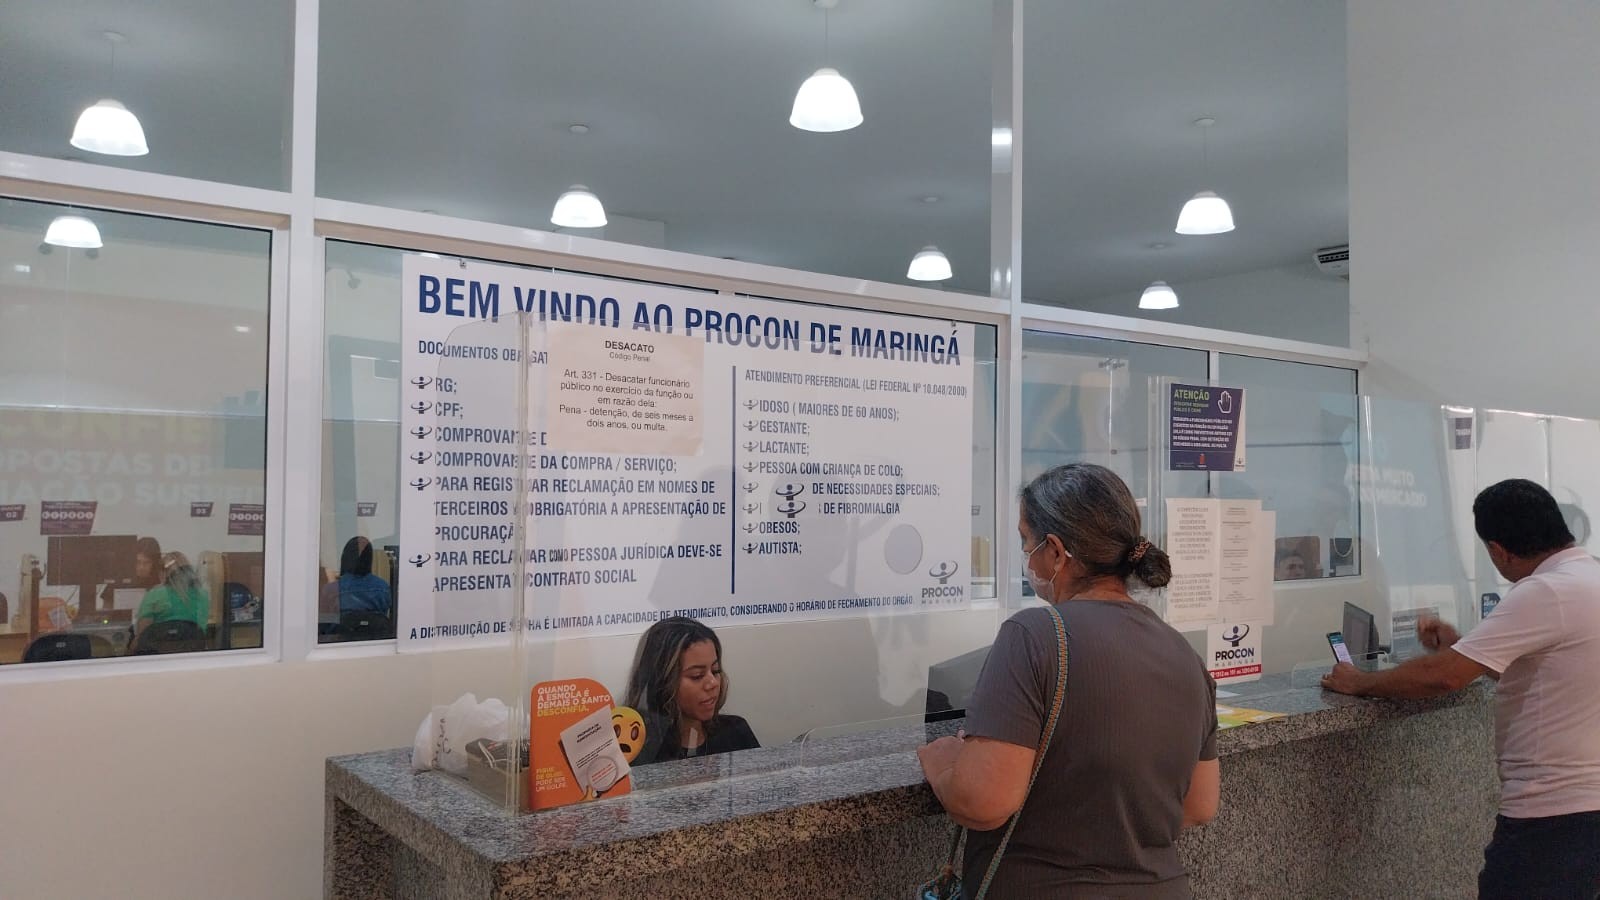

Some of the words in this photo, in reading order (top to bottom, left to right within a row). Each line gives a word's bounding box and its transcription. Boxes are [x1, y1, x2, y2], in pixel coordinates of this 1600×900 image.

[419, 275, 500, 323] BEM
[514, 286, 620, 329] VINDO
[633, 302, 673, 334] AO
[685, 307, 800, 352] PROCON
[810, 322, 842, 355] DE
[851, 327, 961, 366] MARINGÁ
[418, 340, 498, 361] DOCUMENTOS
[605, 340, 655, 354] DESACATO
[609, 352, 632, 361] Código
[633, 353, 651, 362] Penal
[435, 377, 457, 395] RG;
[564, 369, 579, 379] Art.
[581, 371, 597, 380] 331
[605, 372, 647, 384] Desacatar
[649, 376, 691, 388] funcionário
[745, 369, 803, 385] ATENDIMENTO
[805, 375, 861, 390] PREFERENCIAL
[862, 378, 877, 392] (LEI
[879, 380, 911, 393] FEDERAL
[923, 383, 968, 398] 10.048/2000)
[560, 382, 591, 392] público
[605, 385, 642, 395] exercício
[644, 387, 654, 396] da
[656, 388, 682, 400] função
[1174, 389, 1210, 402] ATENÇÃO
[613, 397, 635, 406] razão
[435, 401, 464, 420] CPF;
[559, 405, 581, 415] Pena
[589, 407, 629, 419] detenção,
[632, 408, 643, 418] de
[645, 410, 660, 419] seis
[662, 412, 687, 421] meses
[759, 400, 790, 414] IDOSO
[798, 402, 839, 417] MAIORES
[841, 404, 854, 417] DE
[855, 405, 867, 418] 60
[869, 406, 900, 421] ANOS);
[587, 419, 604, 428] dois
[759, 420, 810, 436] GESTANTE;
[759, 441, 810, 456] LACTANTE;
[541, 455, 558, 470] DA
[561, 456, 613, 471] COMPRA
[624, 457, 677, 475] SERVIÇO;
[759, 461, 798, 475] PESSOA
[800, 463, 821, 476] COM
[822, 463, 862, 478] CRIANÇA
[864, 465, 876, 476] DE
[878, 465, 904, 478] COLO;
[435, 476, 469, 492] PARA
[553, 477, 634, 496] RECLAMAÇÃO
[638, 480, 655, 493] EM
[658, 480, 698, 494] NOMES
[701, 481, 715, 494] DE
[812, 482, 825, 495] DE
[826, 483, 893, 496] NECESSIDADES
[895, 483, 941, 497] ESPECIAIS;
[434, 501, 508, 516] TERCEIROS
[611, 502, 618, 516] A
[622, 500, 709, 518] APRESENTAÇÃO
[713, 502, 726, 515] DE
[823, 502, 836, 514] DE
[838, 502, 901, 515] FIBROMIALGIA
[759, 521, 800, 535] OBESOS;
[434, 551, 468, 567] PARA
[549, 548, 569, 562] COMO
[571, 547, 617, 562] PESSOA
[620, 543, 674, 560] JURÍDICA
[678, 544, 722, 559] DEVE-SE
[759, 541, 802, 554] AUTISTA;
[526, 571, 591, 588] CONTRATO
[594, 569, 637, 584] SOCIAL
[921, 586, 964, 599] PROCON
[410, 628, 417, 639] A
[420, 621, 490, 639] DISTRIBUIÇÃO
[493, 621, 506, 633] DE
[552, 614, 594, 629] LIMITADA
[596, 615, 603, 626] A
[605, 611, 658, 626] CAPACIDADE
[660, 611, 671, 621] DE
[730, 602, 788, 616] CONSIDERANDO
[827, 599, 837, 610] DE
[838, 597, 881, 609] FECHAMENTO
[1215, 648, 1255, 661] PROCON
[537, 684, 577, 695] QUANDO
[546, 690, 582, 702] ESMOLA
[583, 688, 590, 697] É
[537, 699, 571, 710] DEMAIS
[572, 698, 581, 706] O
[581, 694, 611, 704] SANTO
